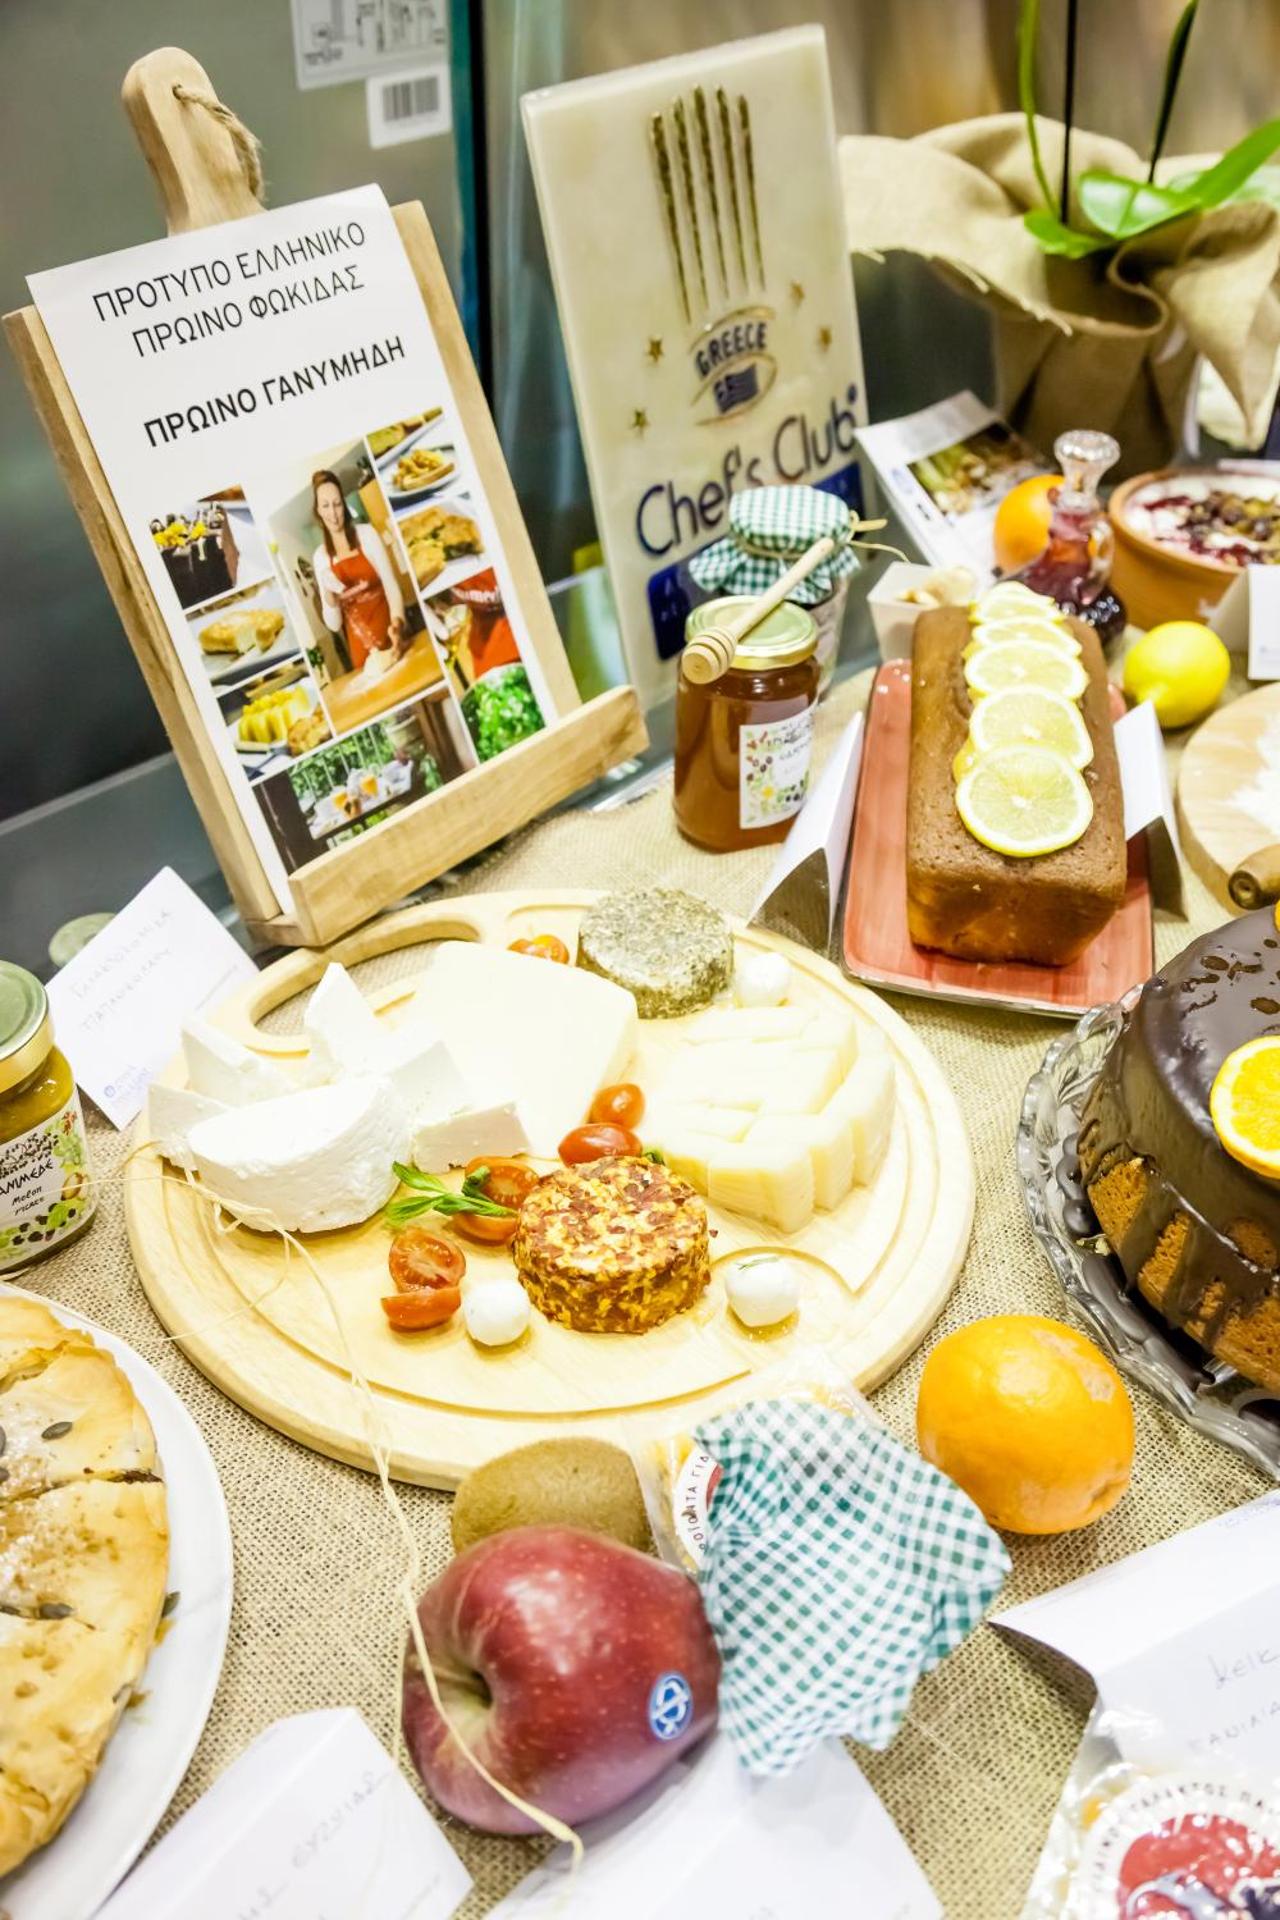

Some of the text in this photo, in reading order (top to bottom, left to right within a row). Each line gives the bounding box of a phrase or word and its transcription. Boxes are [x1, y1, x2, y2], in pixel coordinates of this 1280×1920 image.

[93, 220, 367, 322] ΠΡΟΤΥΠΟ ΕΛΛΗΝΙΚΟ
[132, 264, 366, 358] ΠΡΩΙΝΟ ΦΩΚΙΔΑΣ
[143, 335, 406, 448] ΠΡΩΙΝΟ ΓΑΝΥΜΗΔΗ
[695, 322, 768, 379] GREECE
[773, 400, 857, 481] Club
